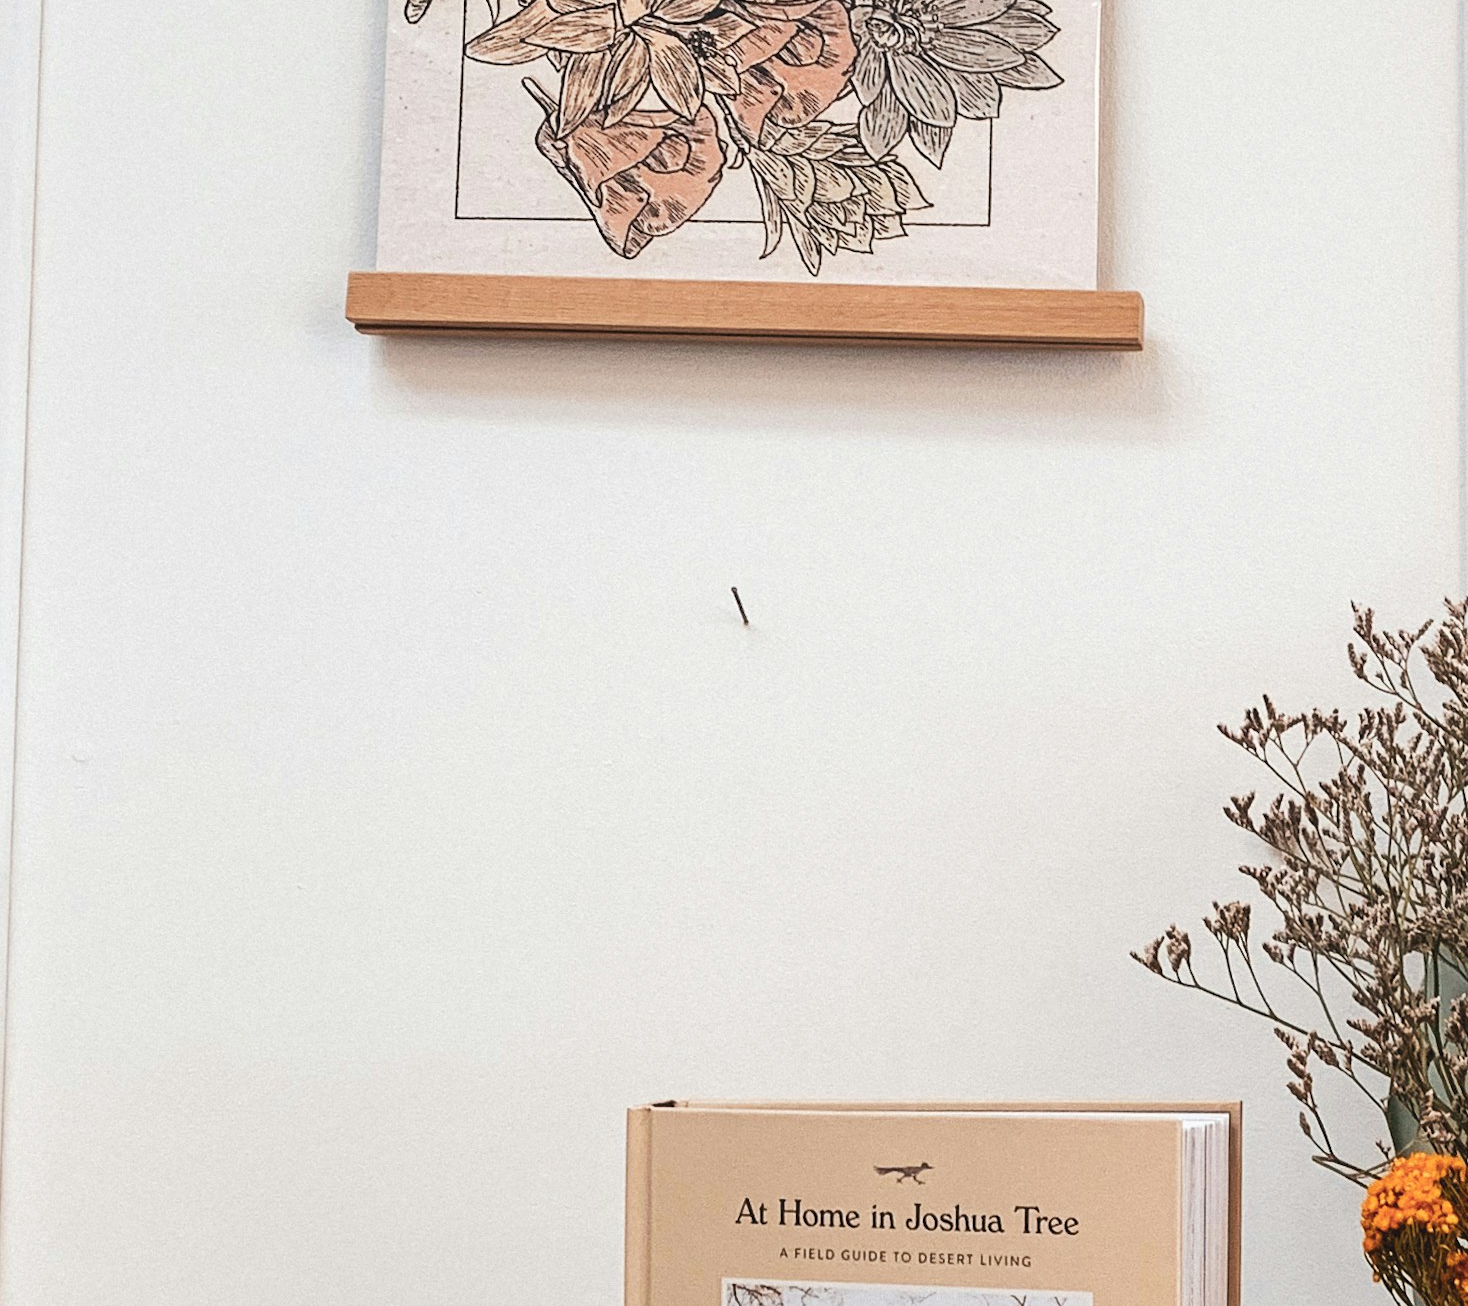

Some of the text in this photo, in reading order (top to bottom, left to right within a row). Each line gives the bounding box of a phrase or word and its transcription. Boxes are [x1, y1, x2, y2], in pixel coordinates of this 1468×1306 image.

[735, 1197, 1080, 1235] At Home in Joshua Tree
[779, 1247, 1032, 1268] A FIELD GUIDE TO DESERT LIVING
